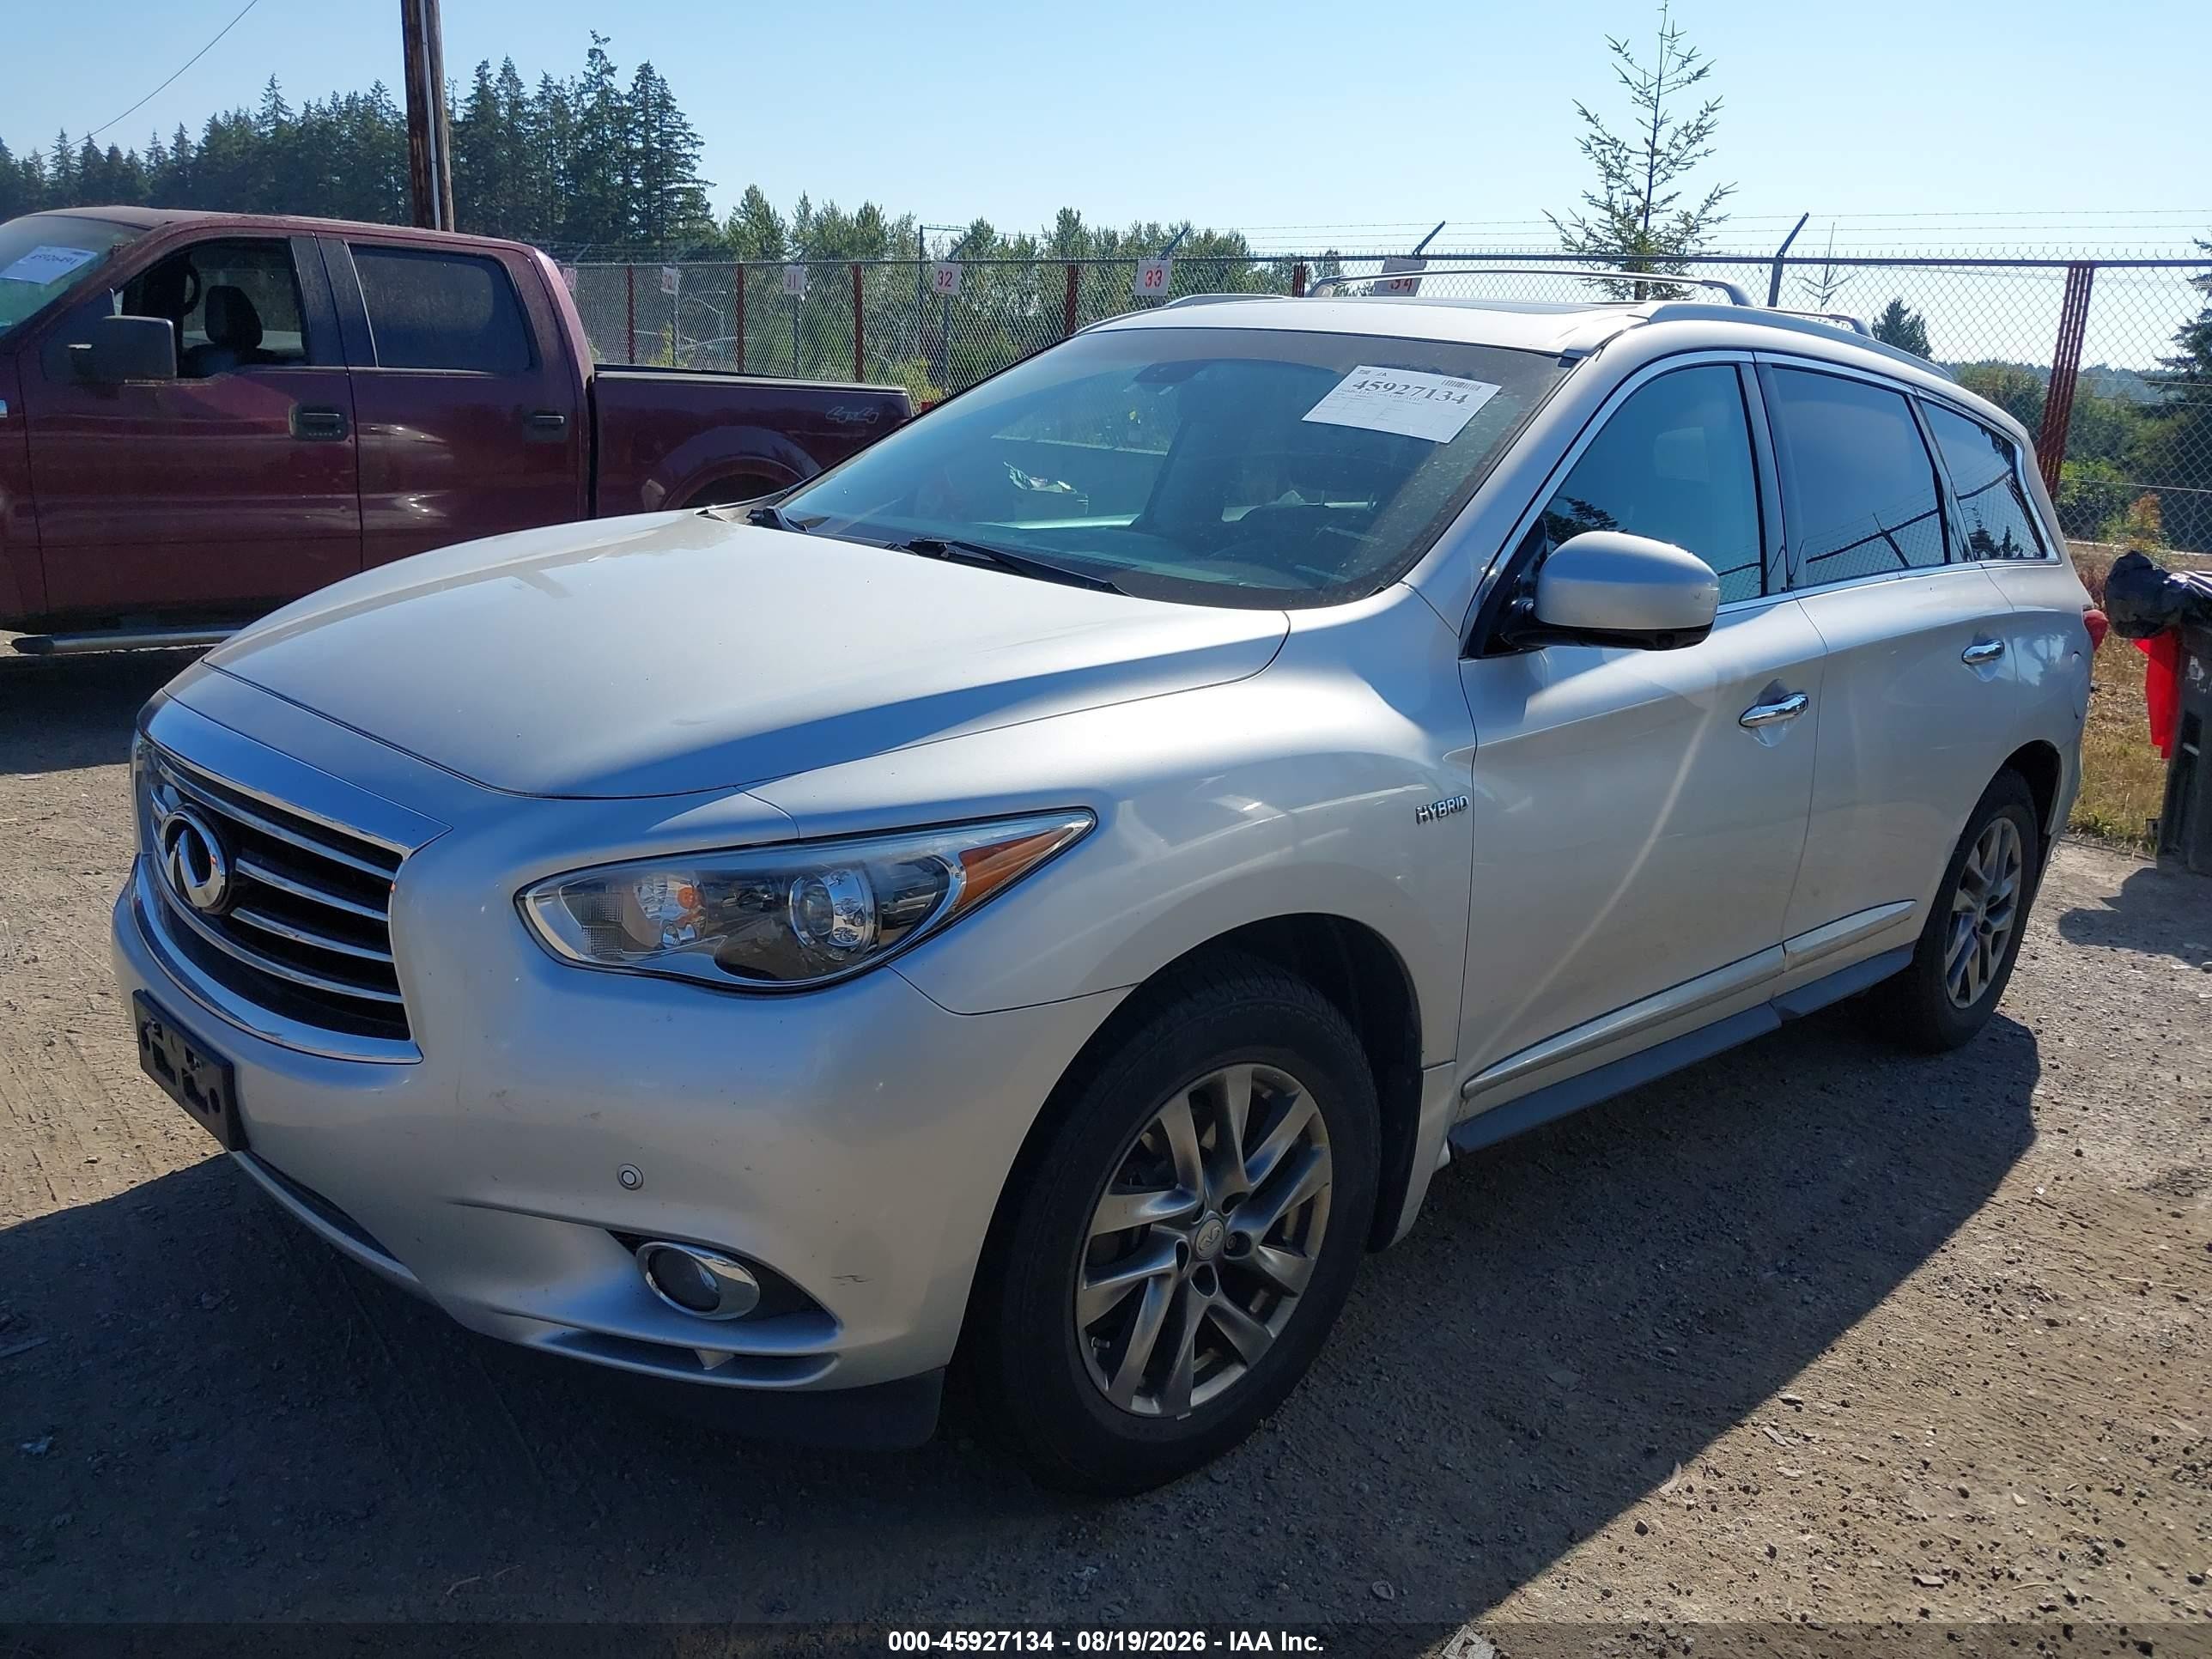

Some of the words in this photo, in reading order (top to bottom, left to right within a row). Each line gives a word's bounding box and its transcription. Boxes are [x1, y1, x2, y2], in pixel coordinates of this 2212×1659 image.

[937, 270, 953, 288] 32
[1145, 269, 1163, 289] 33
[1352, 380, 1469, 404] 45927134
[1415, 795, 1469, 825] HYBRID
